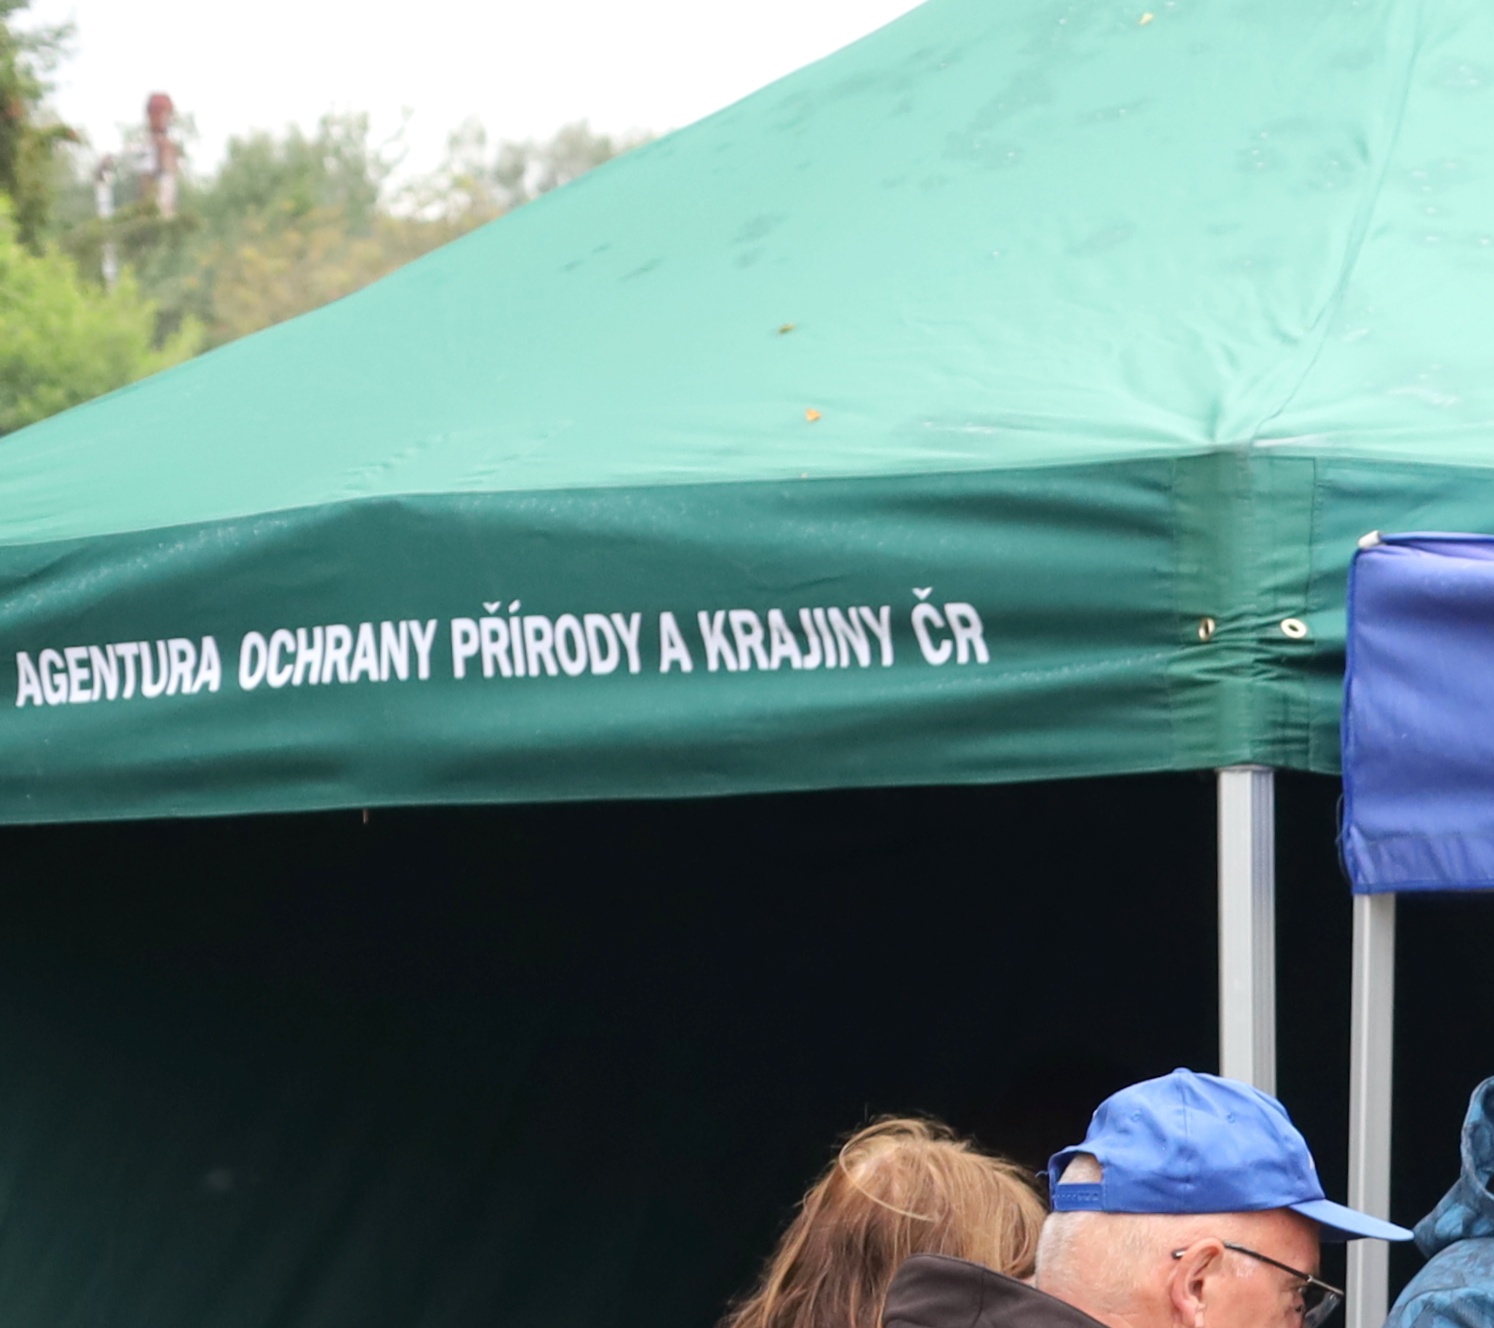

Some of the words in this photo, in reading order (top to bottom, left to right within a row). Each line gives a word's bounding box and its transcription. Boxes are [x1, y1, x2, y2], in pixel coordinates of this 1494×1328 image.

[15, 636, 221, 707] AGENTURA
[238, 618, 437, 691] OCHRANY
[451, 599, 641, 678] PŘÍRODY
[659, 611, 693, 674] A
[698, 605, 894, 672] KRAJINY
[911, 586, 990, 665] ČR
